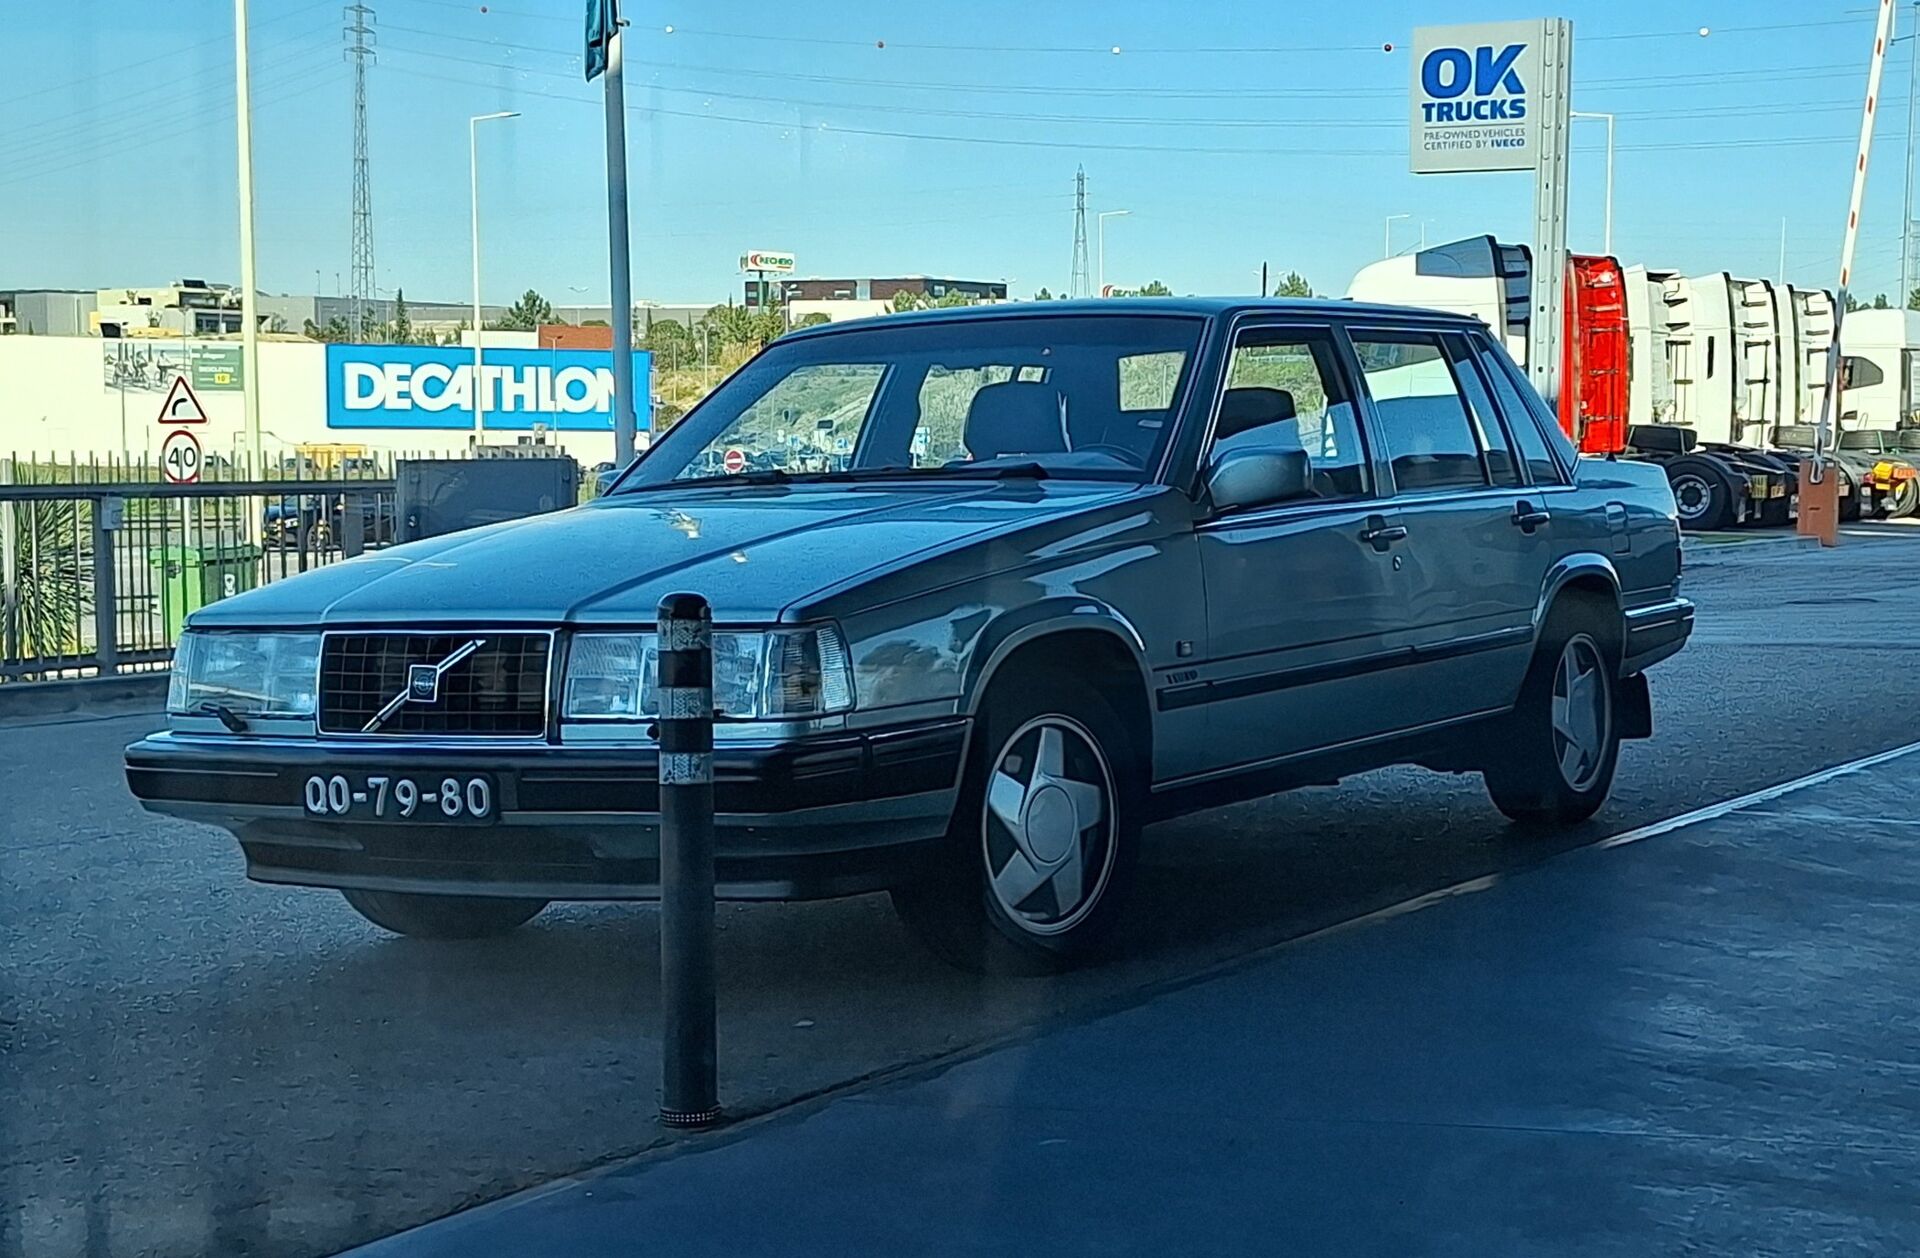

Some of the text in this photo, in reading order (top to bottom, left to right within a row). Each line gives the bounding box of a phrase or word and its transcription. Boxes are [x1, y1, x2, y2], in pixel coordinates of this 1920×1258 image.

[1421, 43, 1528, 99] OK
[1421, 98, 1526, 123] TRUCKS
[1423, 128, 1526, 141] PRE-OWNED VEHICLES
[1423, 137, 1525, 151] CERTIFIED BY IVECO
[168, 446, 196, 468] 40
